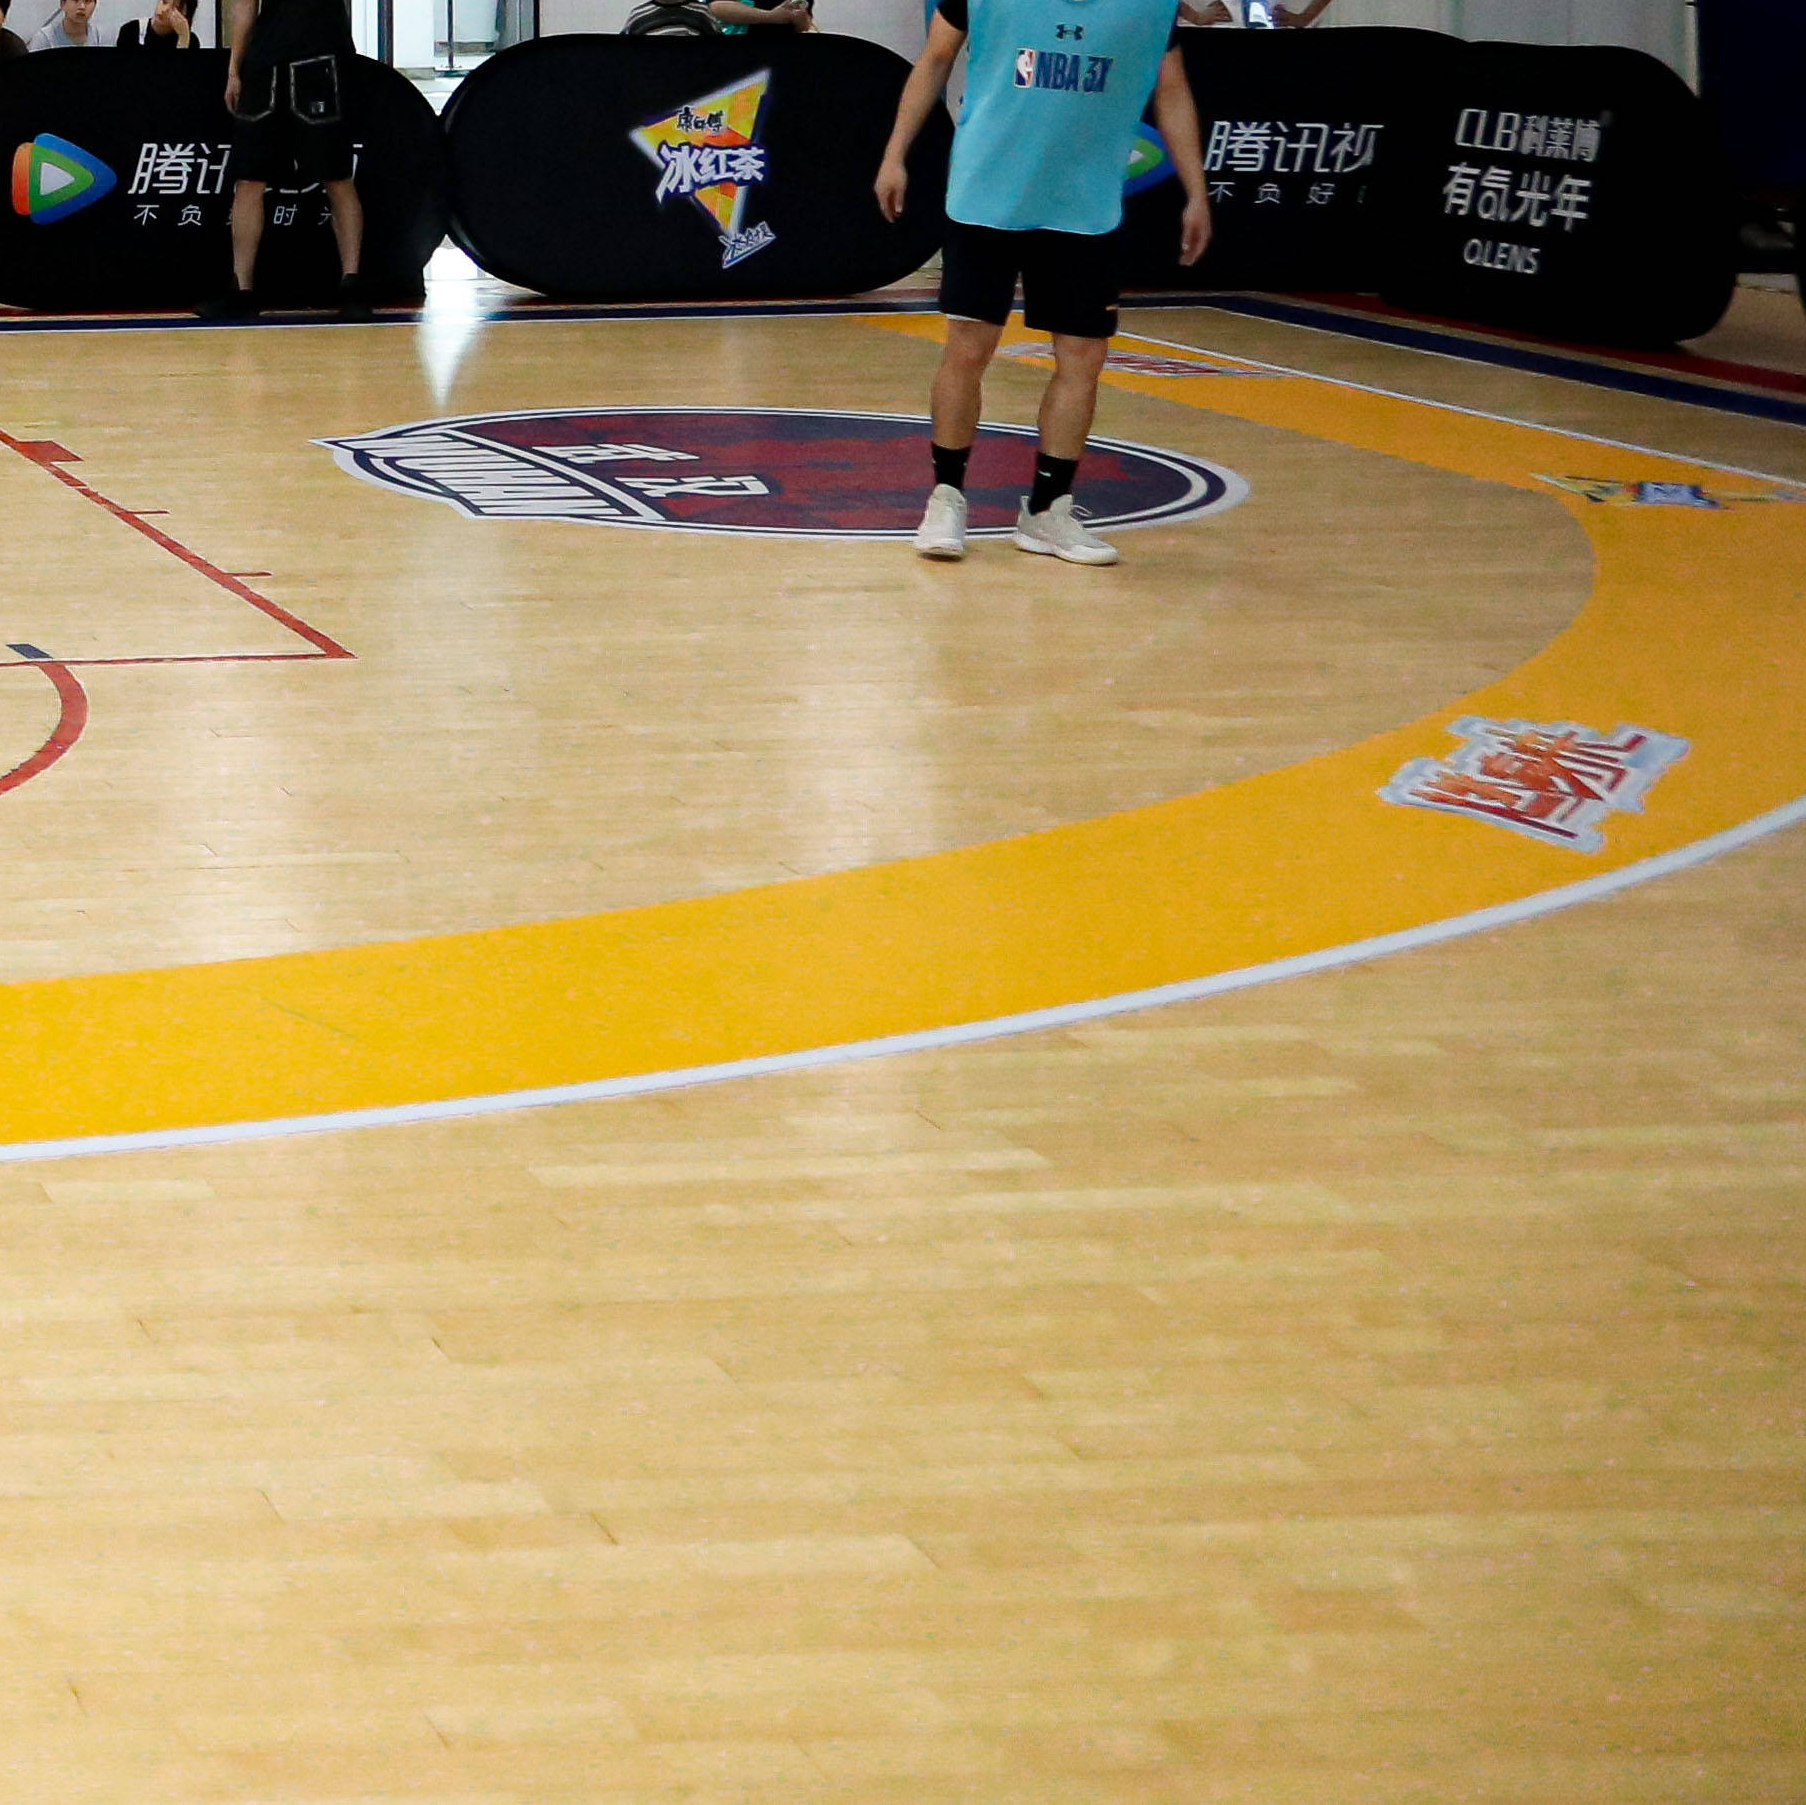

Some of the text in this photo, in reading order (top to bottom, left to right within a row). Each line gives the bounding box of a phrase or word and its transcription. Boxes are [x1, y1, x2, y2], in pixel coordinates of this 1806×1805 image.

[1035, 50, 1081, 92] NBA
[655, 144, 765, 204] 冰红茶
